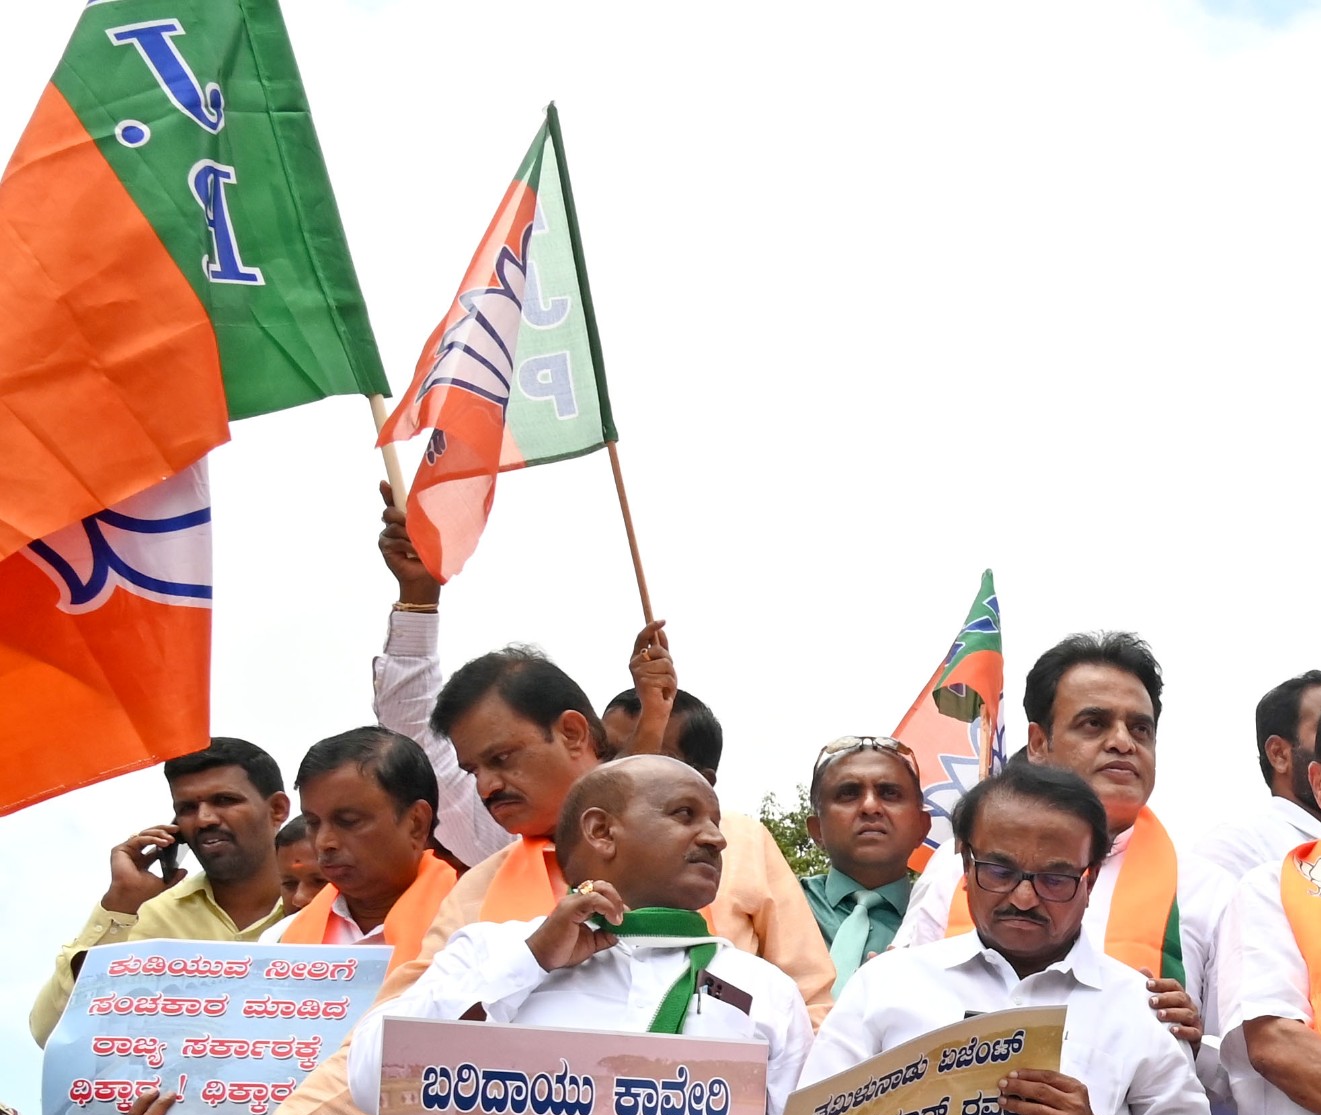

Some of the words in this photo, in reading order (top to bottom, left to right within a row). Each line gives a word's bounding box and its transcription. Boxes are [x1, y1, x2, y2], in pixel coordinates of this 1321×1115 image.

[108, 954, 251, 979] ಕುಡಿಯುವ
[264, 958, 358, 981] ನೀರಿಗೆ
[88, 992, 228, 1016] ಸಂಚಕಾರ
[242, 996, 350, 1019] ಮಾಡಿದ
[93, 1035, 167, 1068] ರಾಜ್ಯ
[181, 1033, 323, 1071] ಸರ್ಕಾರಕ್ಕೆ
[938, 1029, 1026, 1072] ಏಜೆಂಟ್
